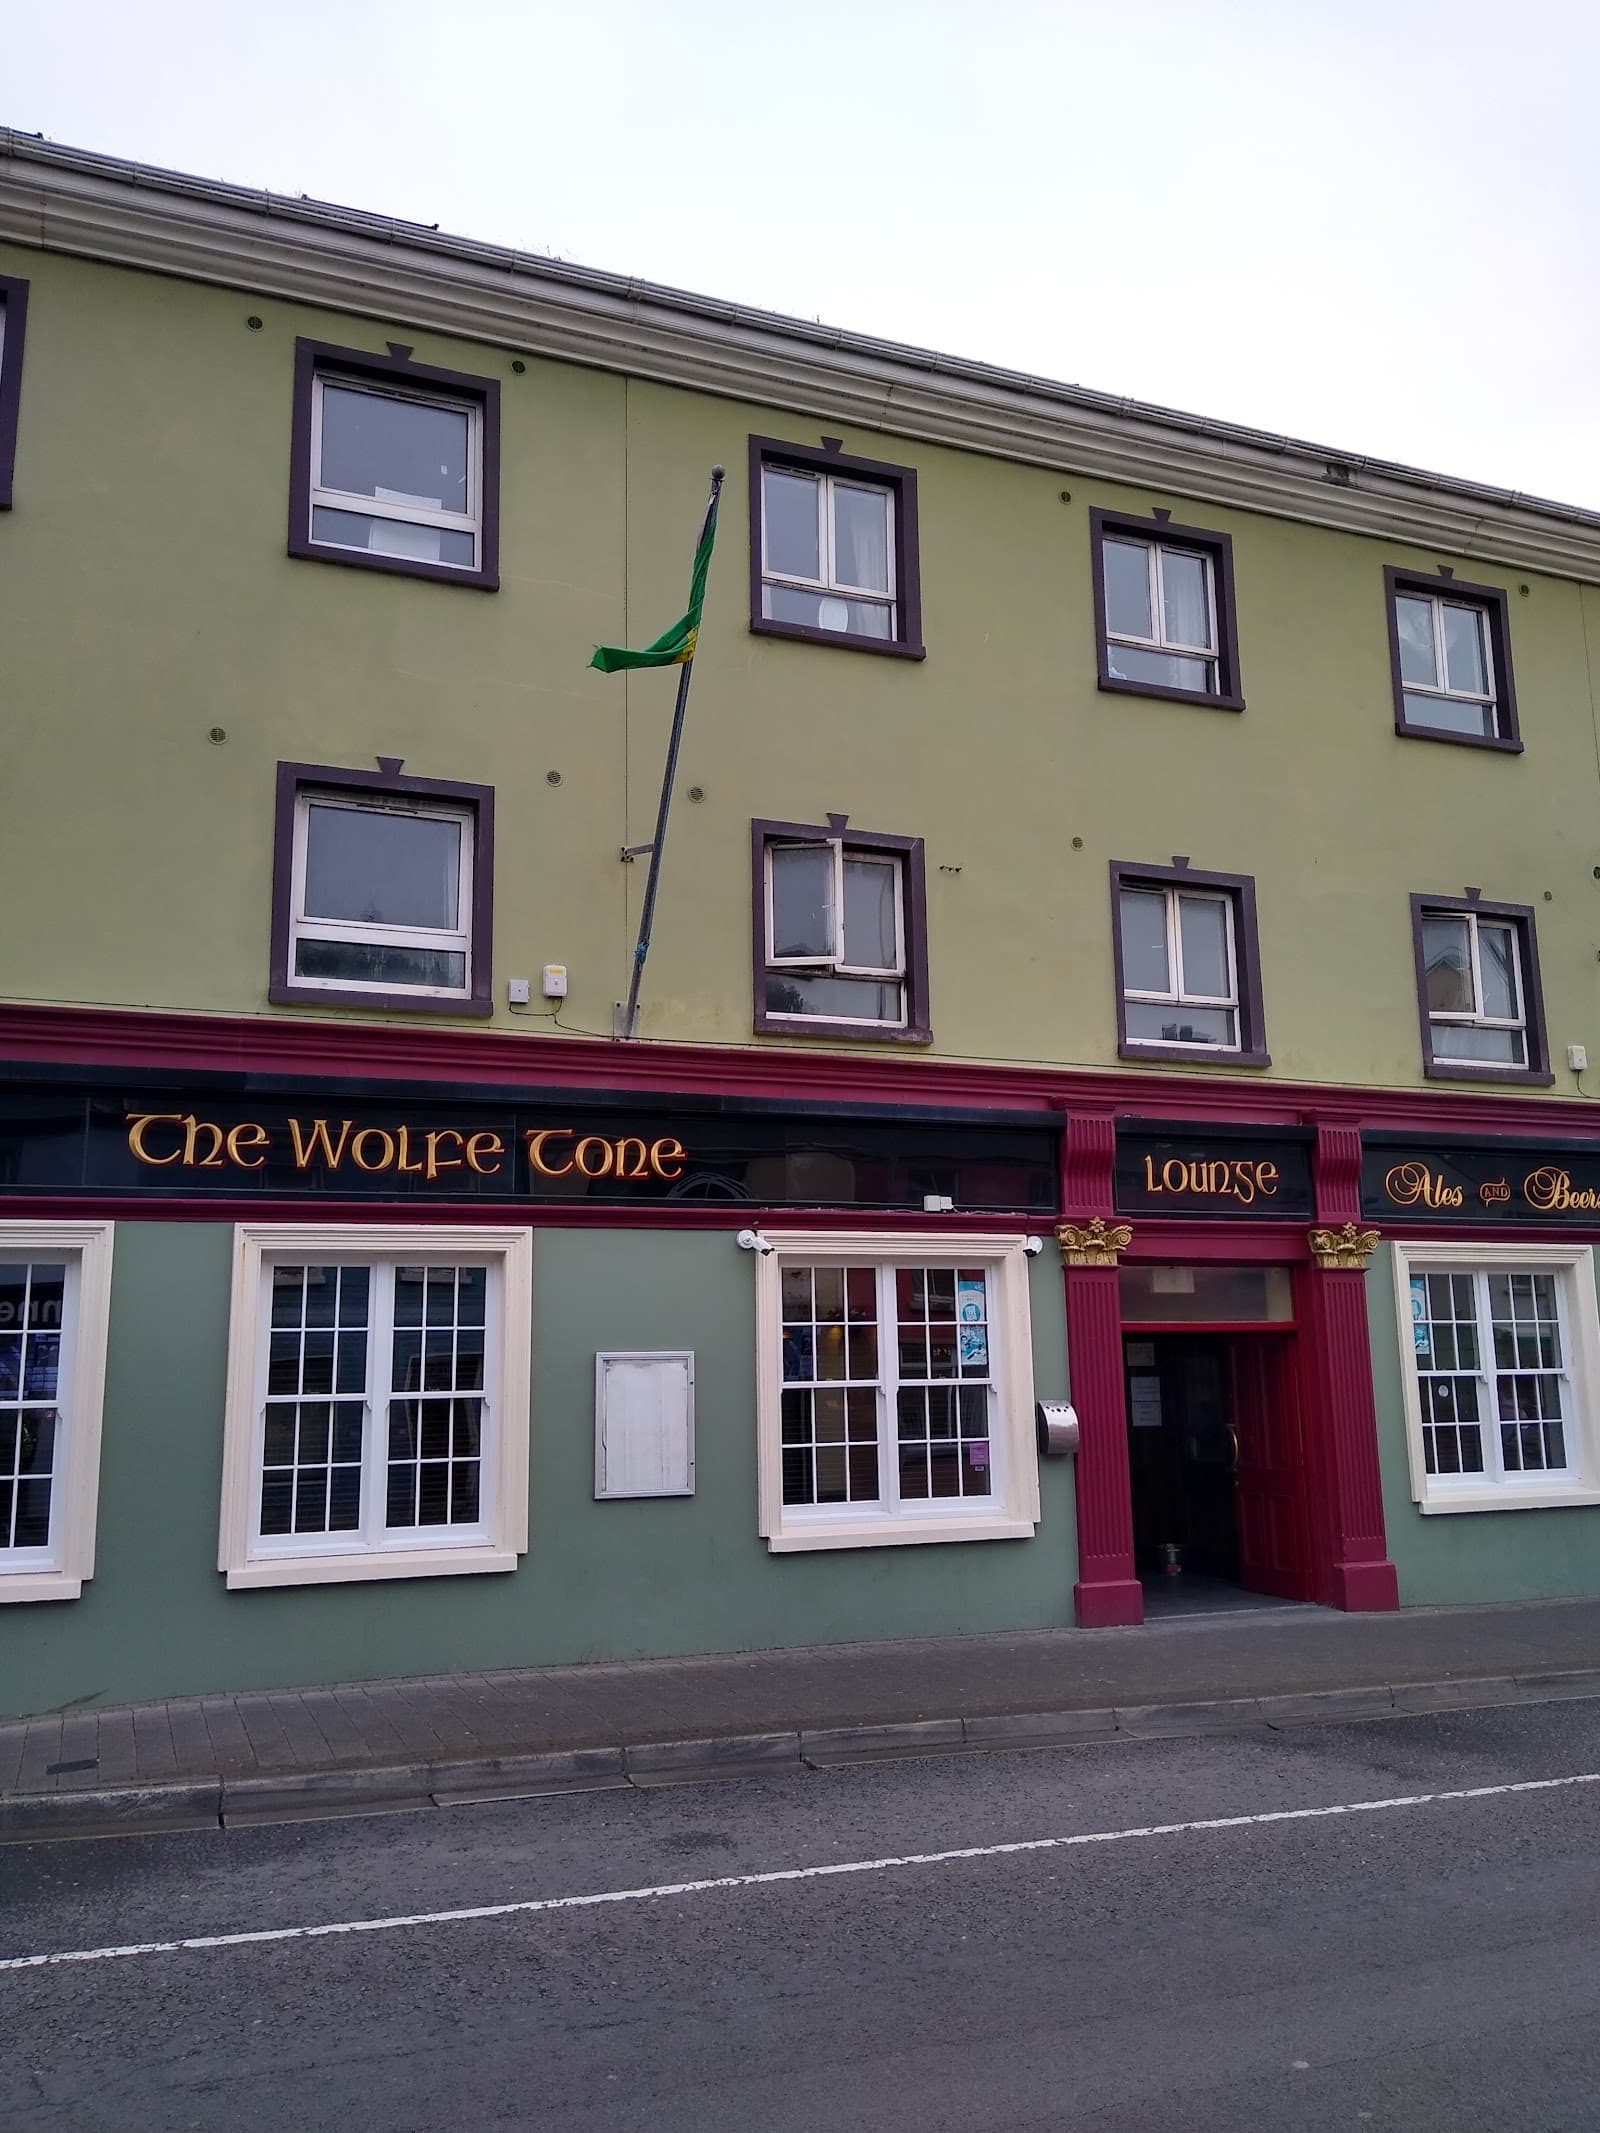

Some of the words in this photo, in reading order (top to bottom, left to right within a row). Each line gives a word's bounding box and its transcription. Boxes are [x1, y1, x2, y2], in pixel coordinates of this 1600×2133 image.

[125, 1113, 270, 1168] The
[287, 1118, 505, 1180] Wolfe
[526, 1128, 686, 1178] Tone
[1144, 1154, 1279, 1204] Lounge
[1385, 1161, 1464, 1209] Ales
[1483, 1188, 1508, 1199] AND
